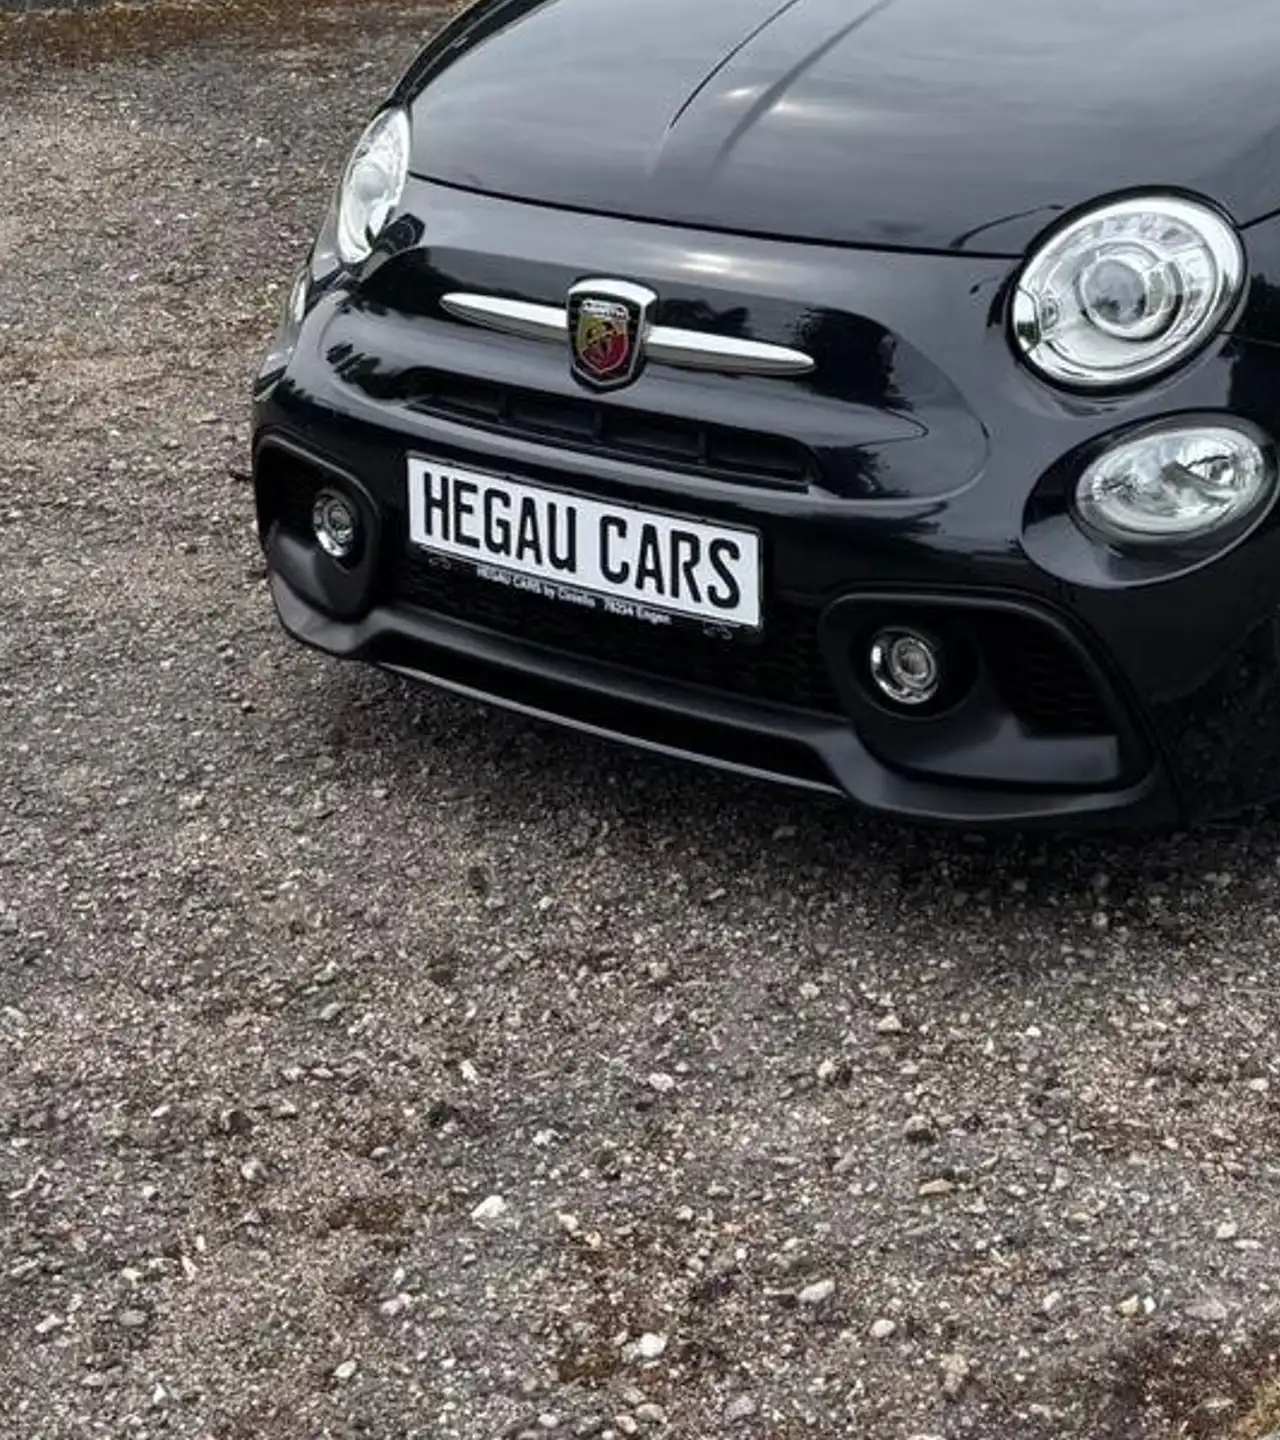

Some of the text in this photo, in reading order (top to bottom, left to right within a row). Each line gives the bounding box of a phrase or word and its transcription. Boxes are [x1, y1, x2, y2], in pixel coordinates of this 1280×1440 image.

[423, 472, 740, 609] HEGAU CARS
[513, 573, 541, 594] CARS
